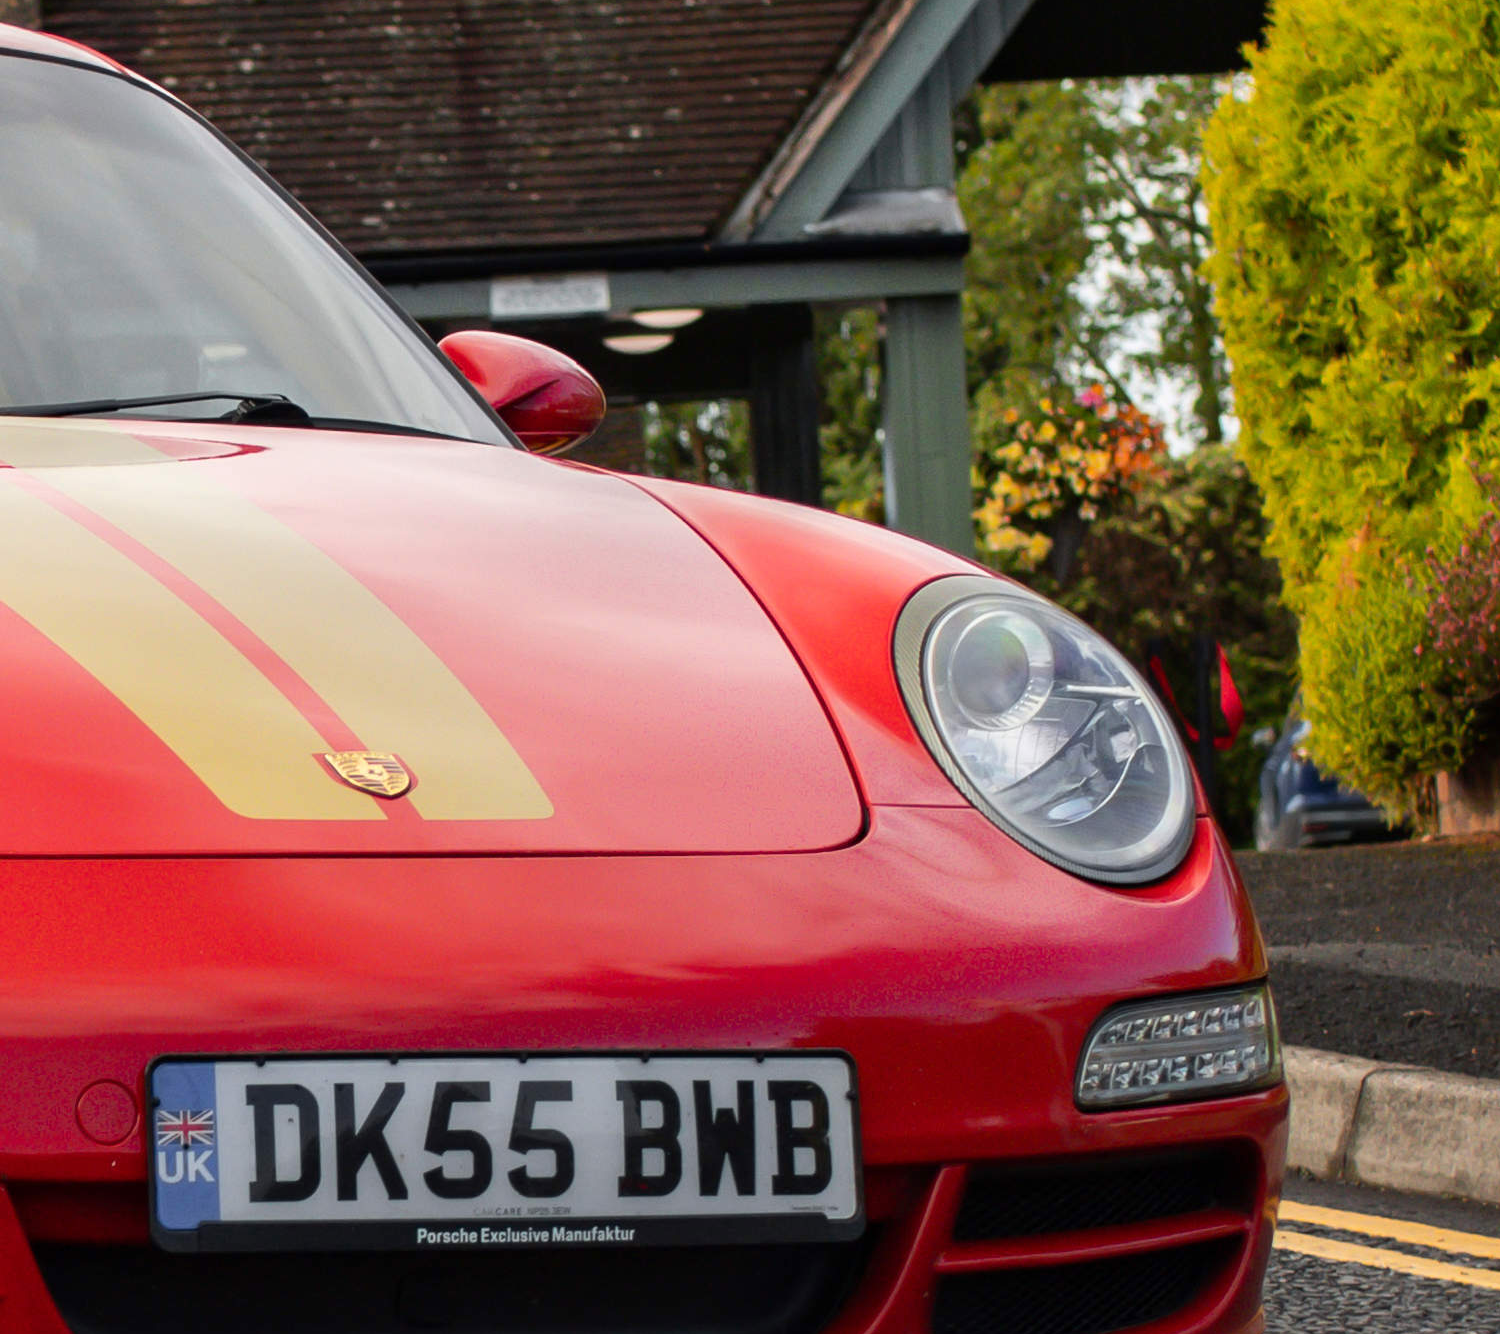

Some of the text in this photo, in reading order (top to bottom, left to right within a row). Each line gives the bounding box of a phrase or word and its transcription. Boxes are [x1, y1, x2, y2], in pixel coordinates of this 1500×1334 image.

[245, 1079, 832, 1202] DK55 BWB
[157, 1149, 216, 1184] UK
[416, 1226, 635, 1244] Porsche Exclusive Manufaktur
